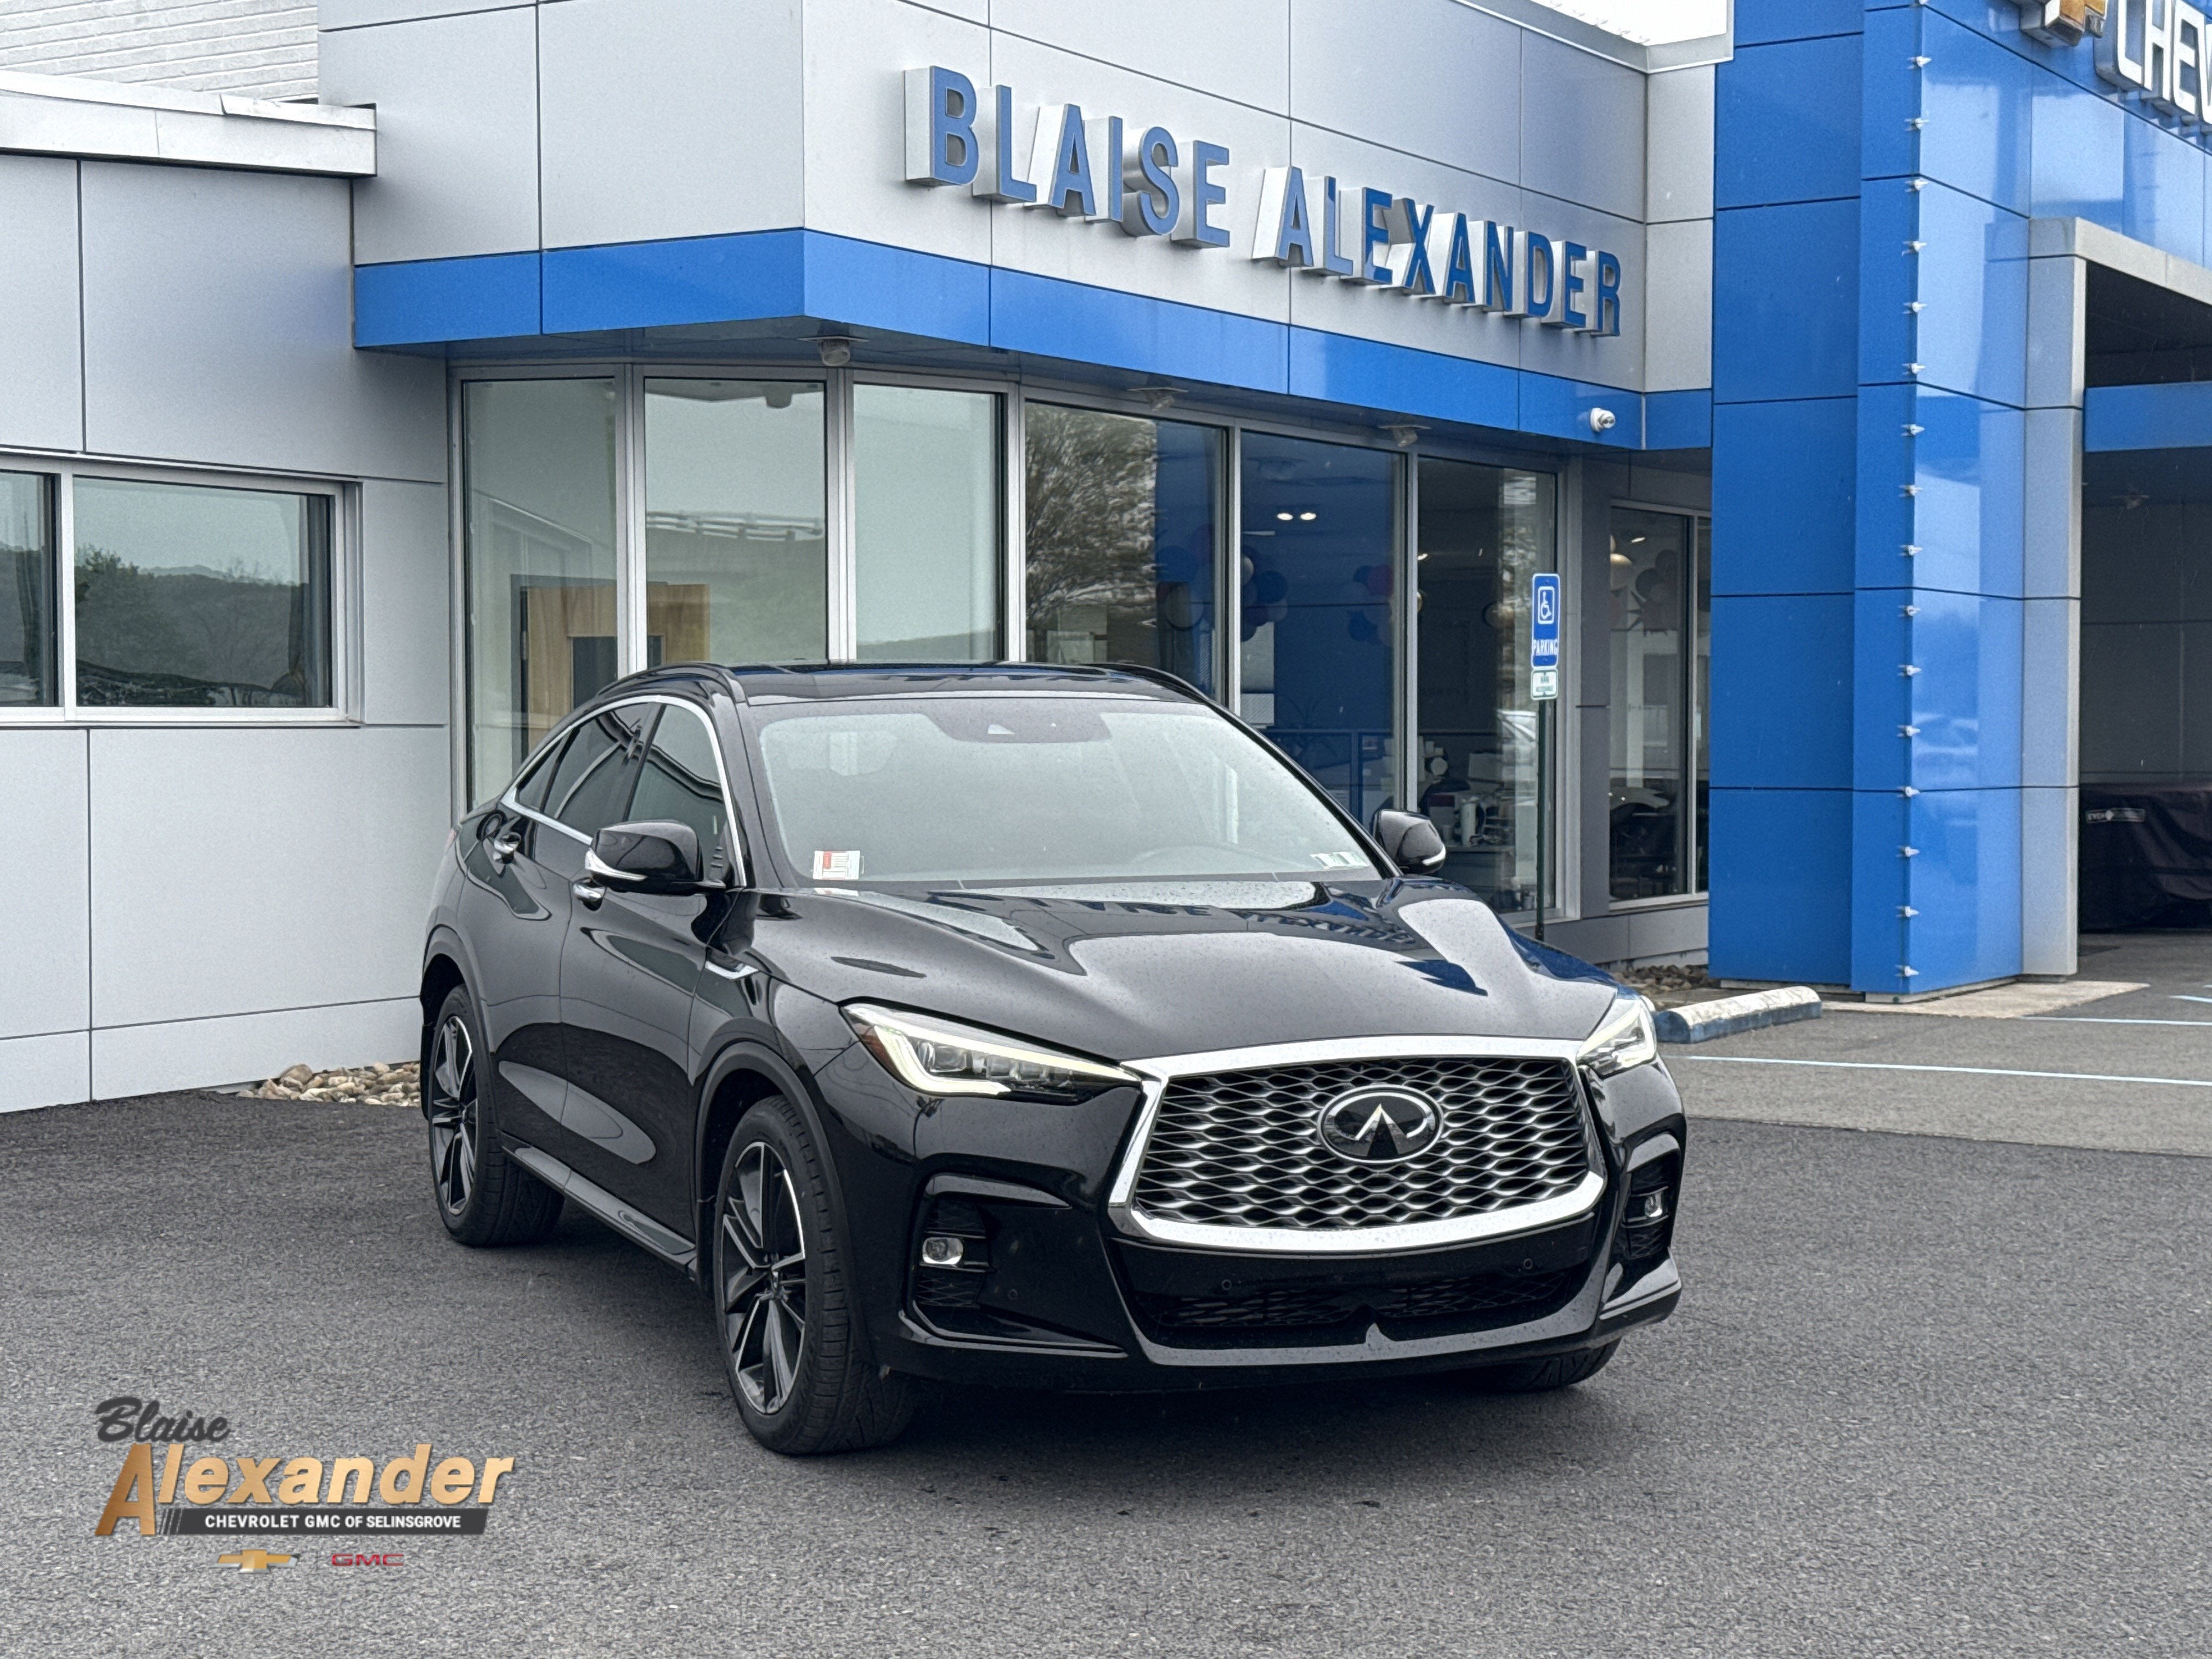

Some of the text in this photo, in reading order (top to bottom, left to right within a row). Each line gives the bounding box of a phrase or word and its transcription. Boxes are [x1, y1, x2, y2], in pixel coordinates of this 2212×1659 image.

[905, 65, 1622, 337] BLAISE ALEXANDER
[1533, 639, 1558, 656] PARKING
